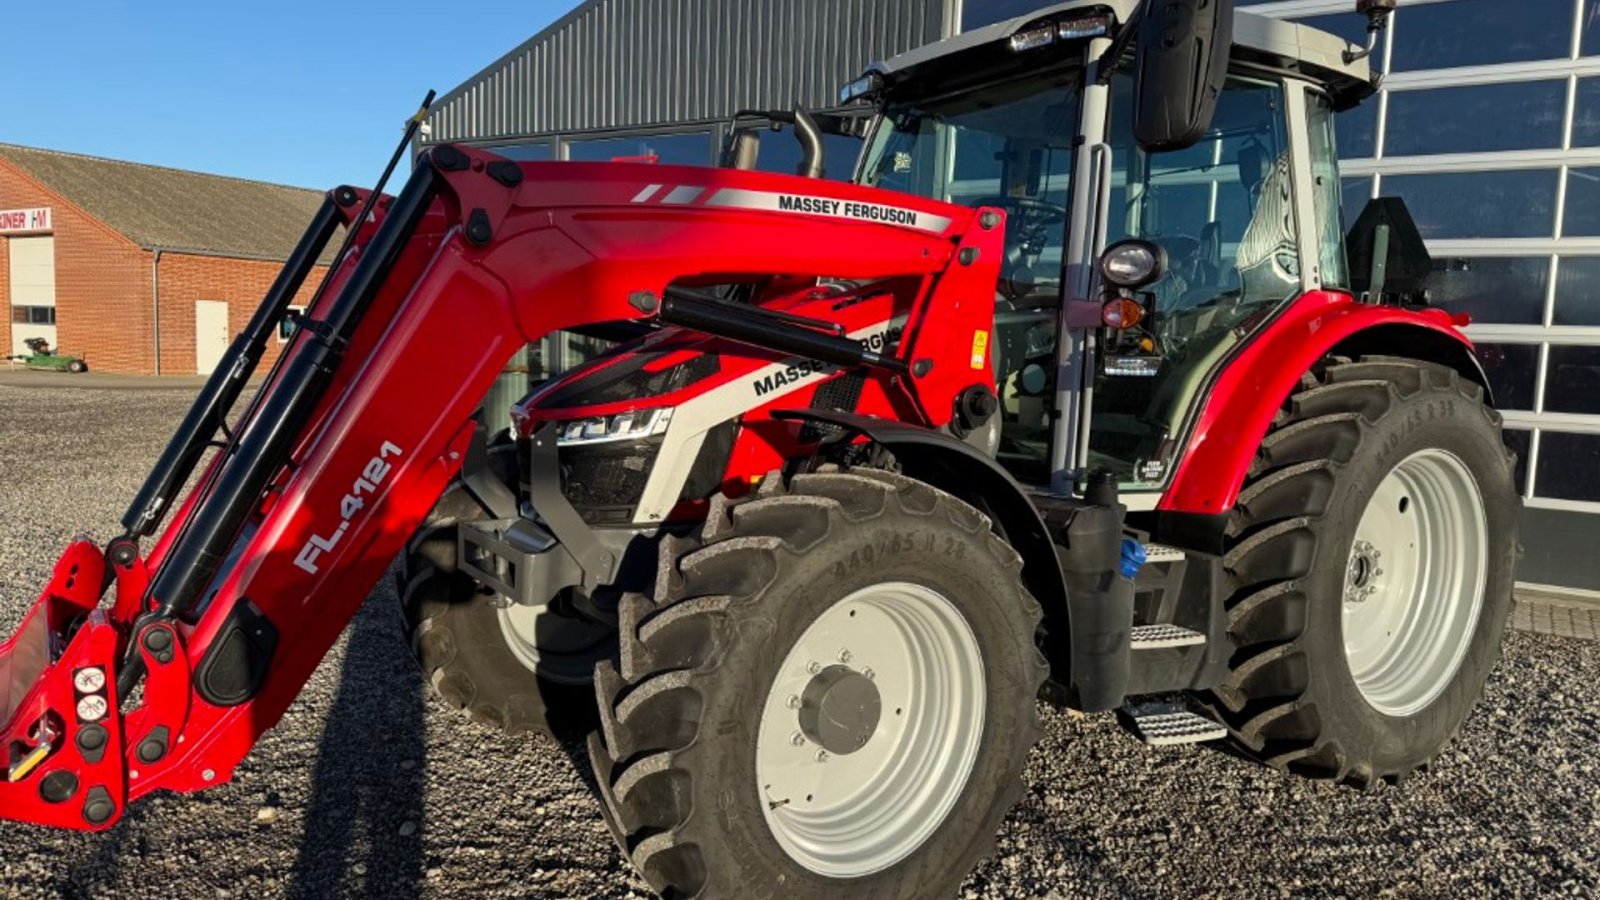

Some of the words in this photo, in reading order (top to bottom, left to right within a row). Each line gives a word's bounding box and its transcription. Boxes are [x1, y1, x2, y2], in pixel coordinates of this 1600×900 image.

[779, 195, 840, 215] MASSEY
[844, 203, 917, 225] FERGUSON
[753, 359, 832, 396] MASSE
[293, 440, 403, 574] FL.4121
